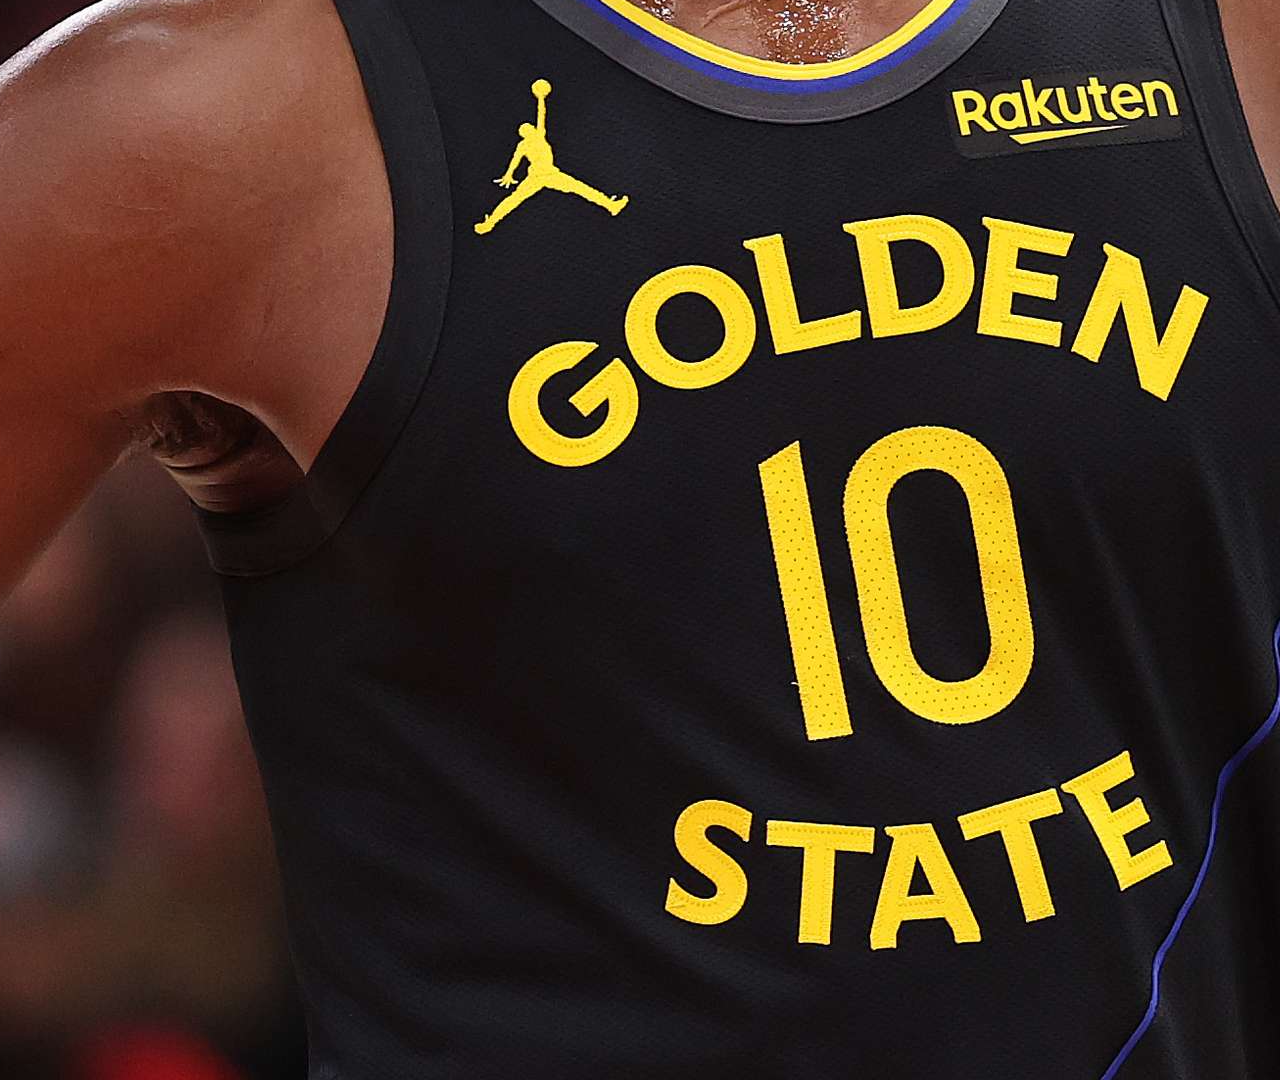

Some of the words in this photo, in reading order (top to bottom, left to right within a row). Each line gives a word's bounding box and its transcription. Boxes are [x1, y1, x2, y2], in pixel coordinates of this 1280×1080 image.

[952, 77, 1179, 136] Rakuten
[508, 215, 1210, 468] GOLDEN
[758, 425, 1035, 741] 10
[664, 750, 1174, 951] STATE
